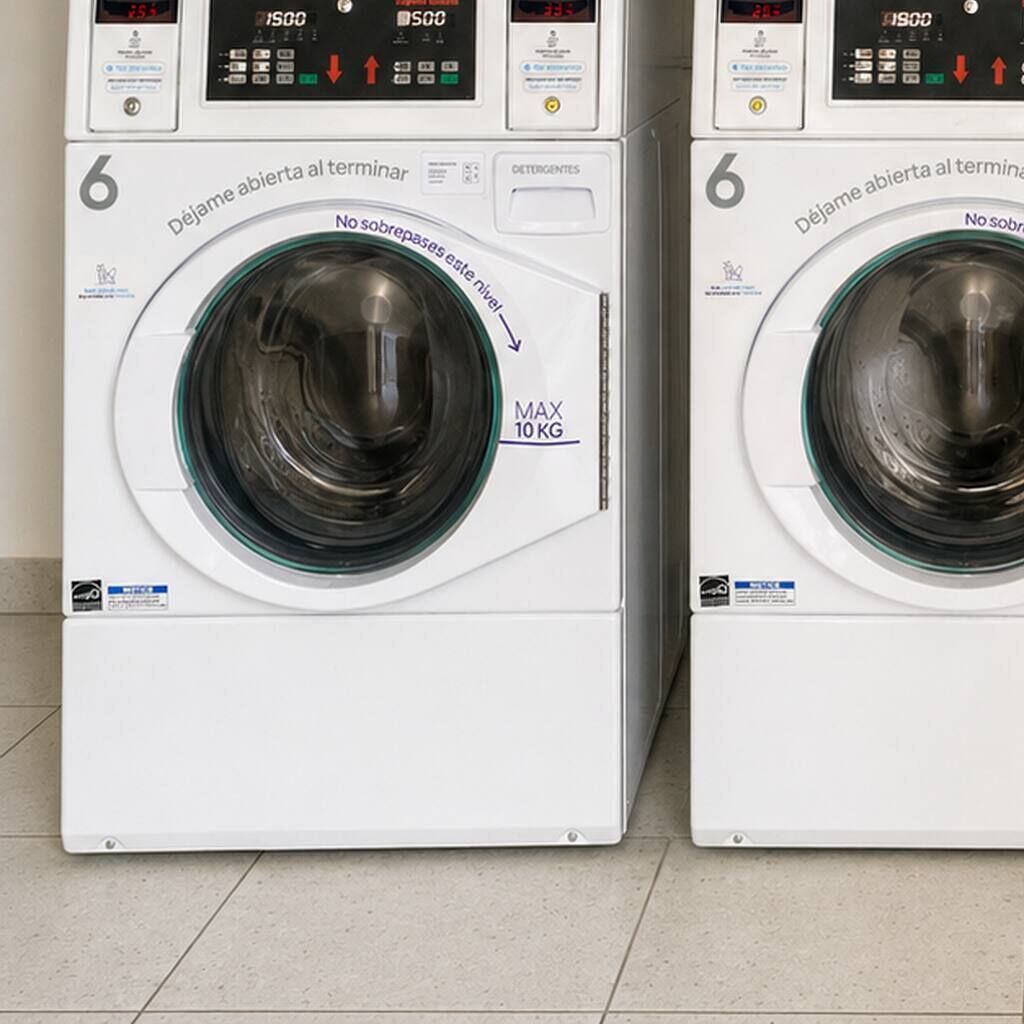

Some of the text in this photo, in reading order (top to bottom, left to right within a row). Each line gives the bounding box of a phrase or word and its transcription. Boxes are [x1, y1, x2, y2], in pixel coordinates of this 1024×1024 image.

[79, 154, 119, 211] 6
[168, 188, 235, 236] Déjame
[237, 164, 304, 196] abierta
[307, 159, 324, 178] al
[326, 159, 409, 182] terminar
[512, 164, 581, 175] DETERGENTES
[705, 153, 745, 209] 6
[794, 186, 863, 235] Déjame
[864, 163, 932, 195] abierta
[935, 158, 951, 176] al
[965, 212, 988, 227] No
[335, 214, 503, 313] No sobrepases este nivel
[515, 401, 564, 420] MAX
[515, 421, 564, 439] 10 KG
